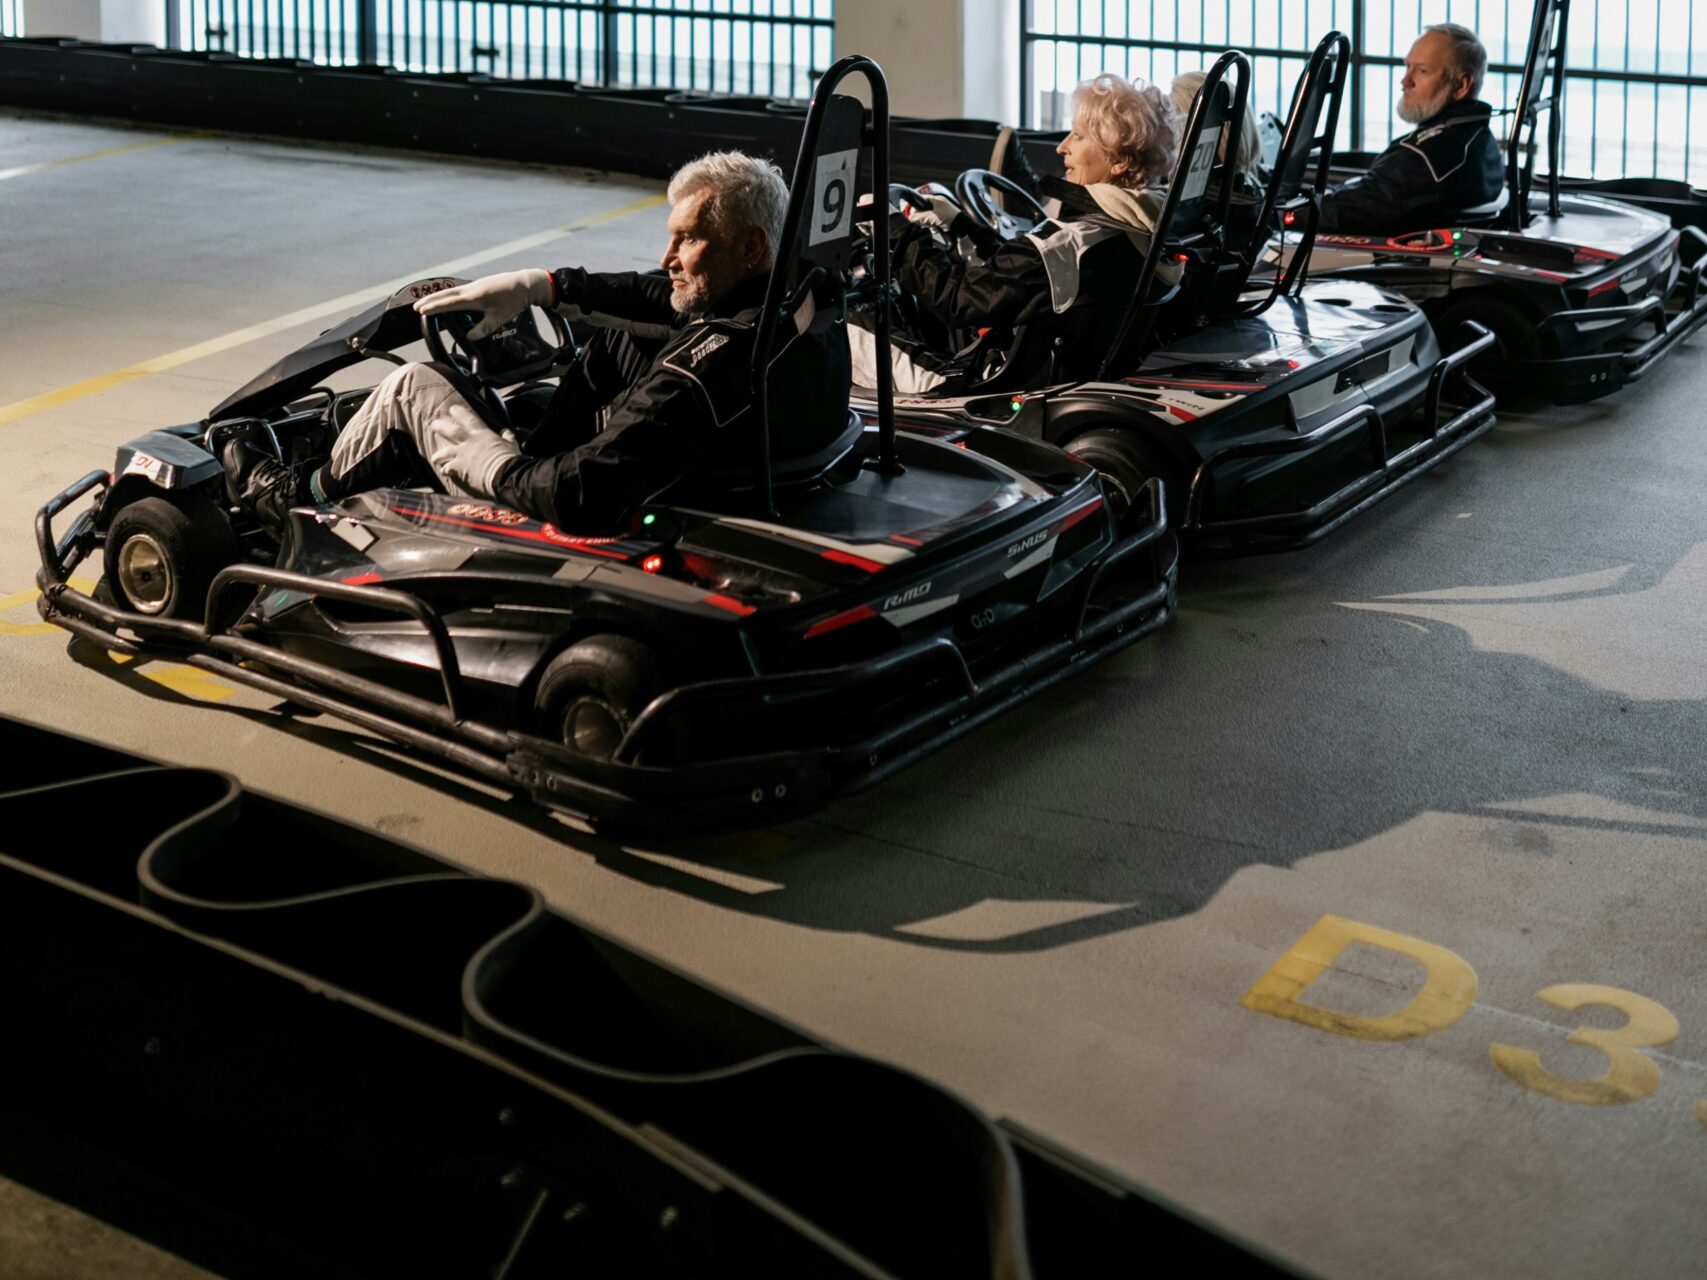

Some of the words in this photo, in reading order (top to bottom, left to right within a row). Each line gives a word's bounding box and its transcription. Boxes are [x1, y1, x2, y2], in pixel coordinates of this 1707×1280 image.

[1189, 142, 1216, 172] 20
[821, 178, 846, 233] 9
[1239, 914, 1707, 1131] D3
